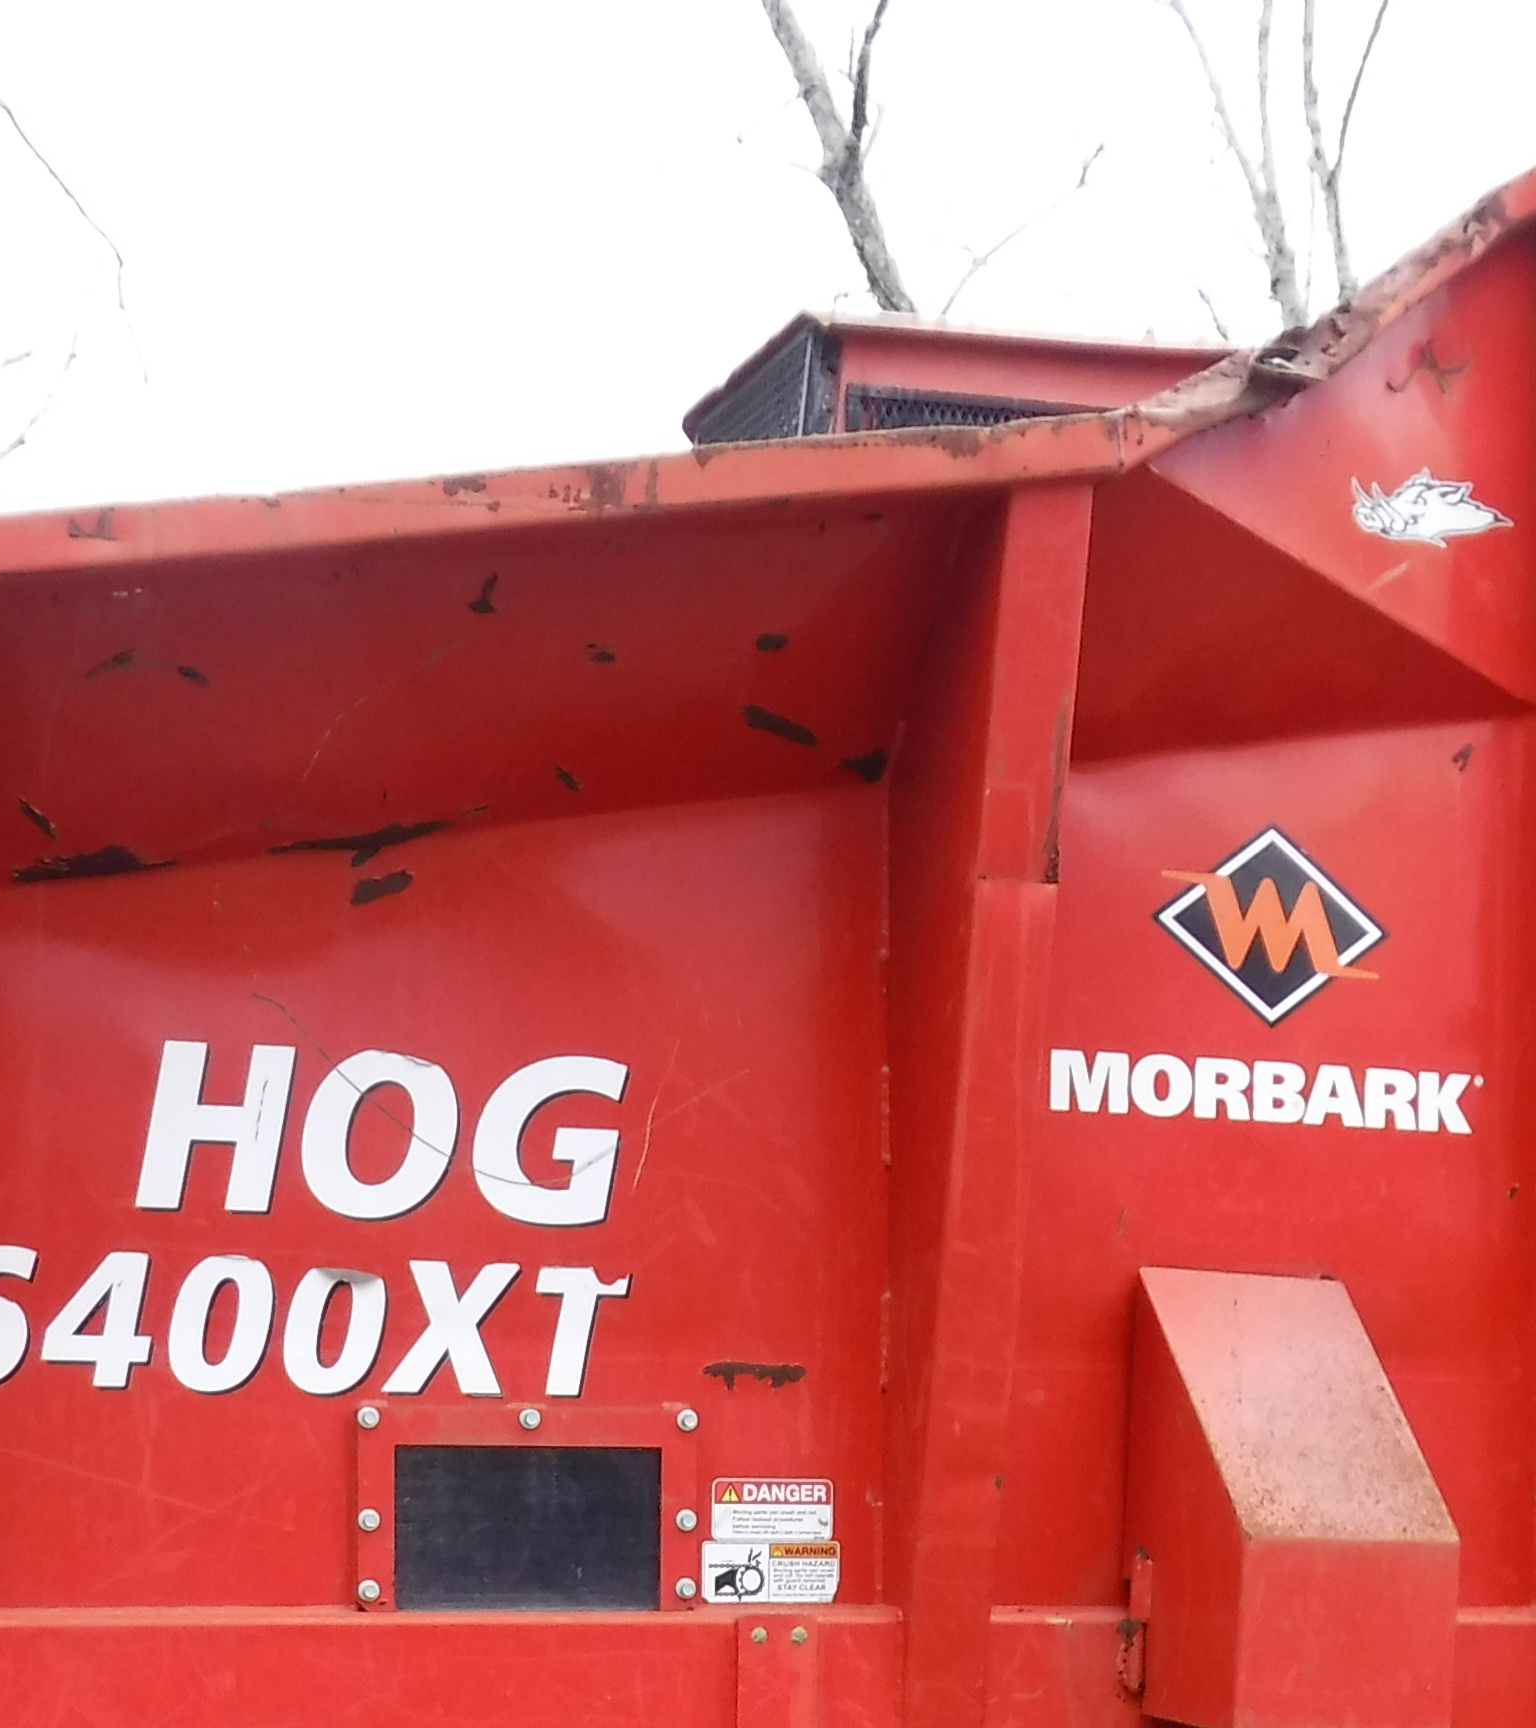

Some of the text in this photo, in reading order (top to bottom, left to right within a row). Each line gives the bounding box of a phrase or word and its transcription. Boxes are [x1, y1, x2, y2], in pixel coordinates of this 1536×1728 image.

[1050, 1049, 1473, 1134] MORBARK
[135, 1040, 629, 1225] HOG
[742, 1483, 827, 1502] DANGER
[784, 1546, 836, 1556] WARNING
